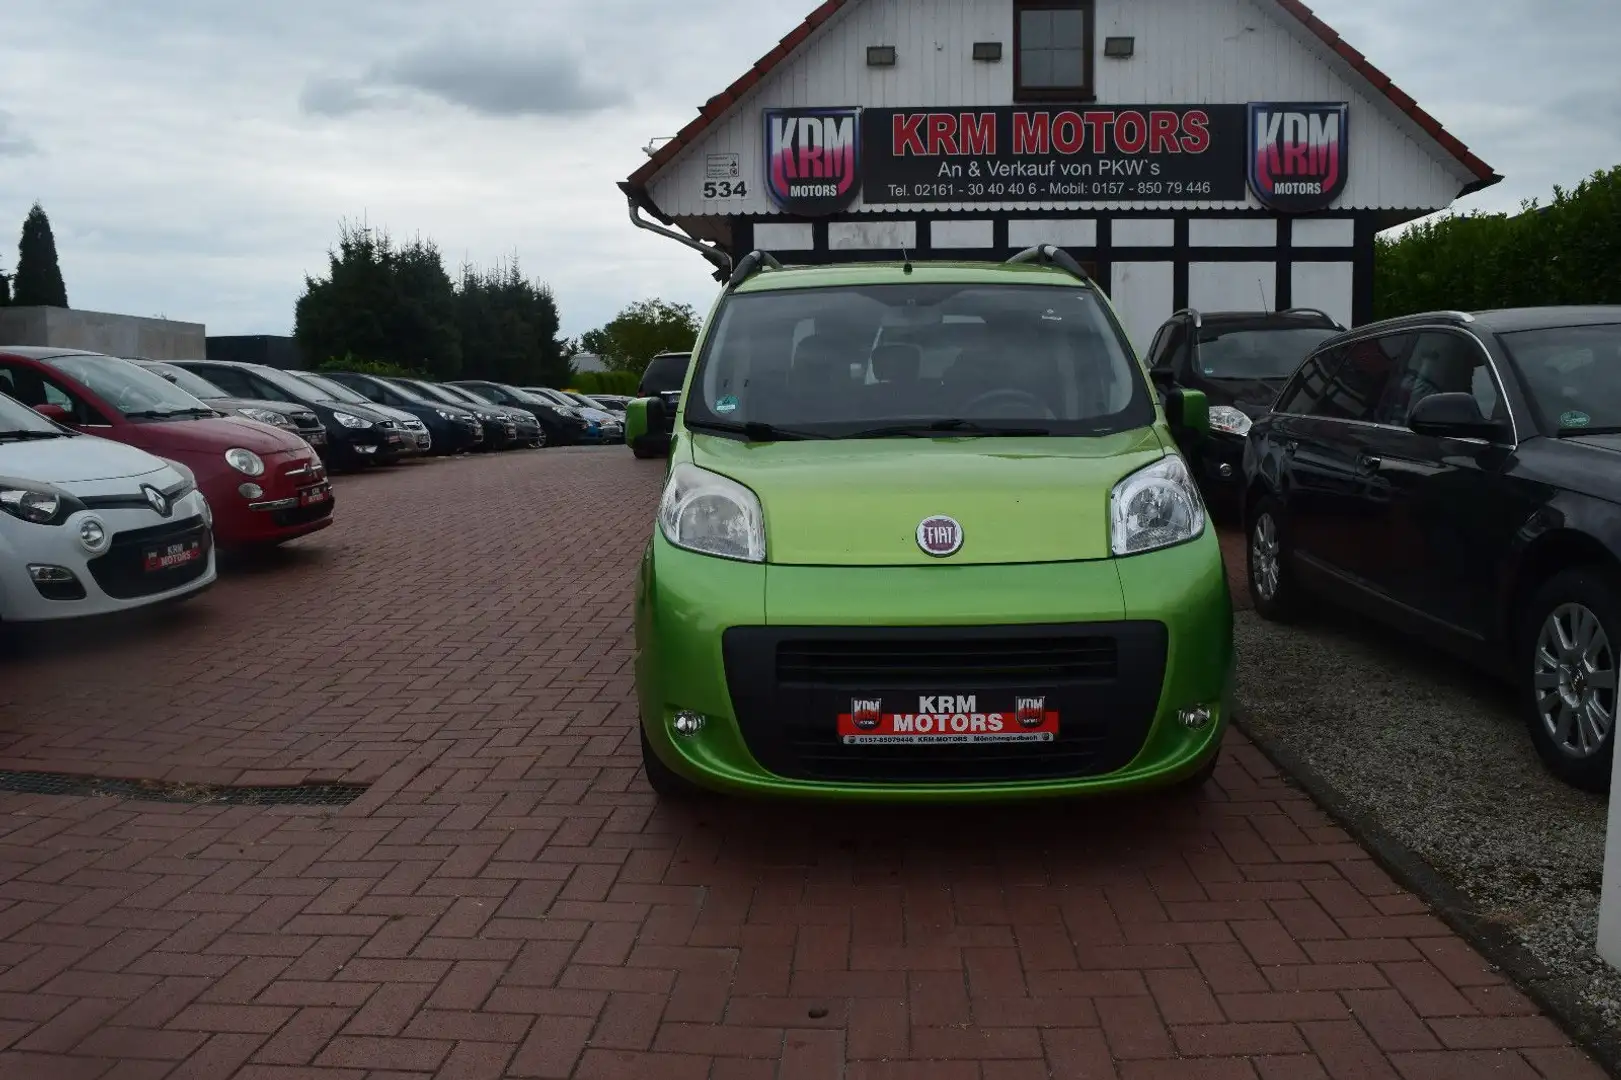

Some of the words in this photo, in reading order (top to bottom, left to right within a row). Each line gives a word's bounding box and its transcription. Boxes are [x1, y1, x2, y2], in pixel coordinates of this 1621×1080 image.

[893, 112, 997, 156] KRM
[1012, 110, 1210, 154] MOTORS
[772, 117, 854, 190] KRM
[1257, 112, 1338, 188] KRM
[937, 160, 962, 178] An
[968, 160, 981, 177] &
[987, 159, 1056, 177] Verkauf
[1060, 163, 1092, 176] von
[703, 181, 747, 198] 534
[790, 184, 837, 197] MOTORS
[888, 184, 910, 196] Tel.
[914, 183, 954, 196] 02161
[968, 183, 984, 195] 30
[987, 183, 1005, 195] 40
[1008, 182, 1025, 195] 40
[1028, 182, 1037, 195] 6
[1049, 181, 1088, 195] Mobil:
[1092, 182, 1125, 194] 0157
[1137, 182, 1162, 194] 850
[1166, 182, 1182, 194] 79
[1186, 181, 1211, 194] 446
[1274, 182, 1321, 194] MOTORS
[926, 526, 954, 544] FIAT
[919, 695, 976, 714] KRM
[893, 713, 1004, 732] MOTORS
